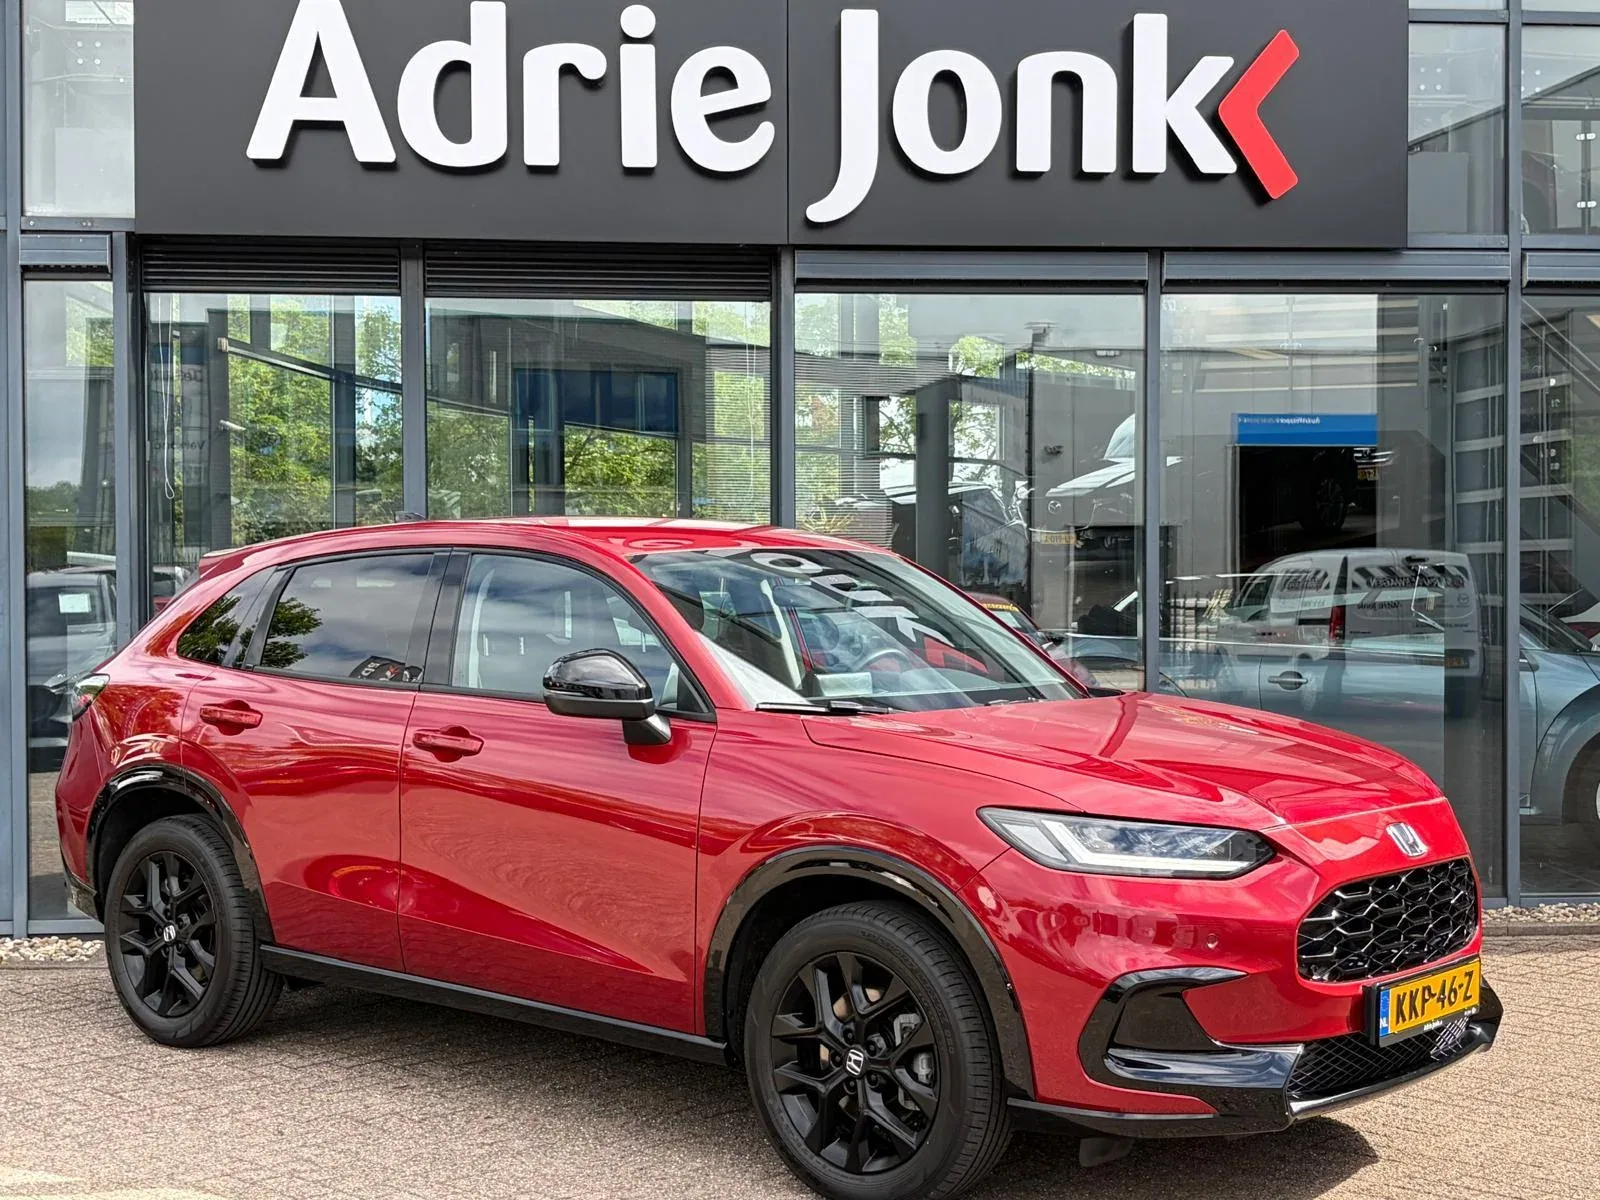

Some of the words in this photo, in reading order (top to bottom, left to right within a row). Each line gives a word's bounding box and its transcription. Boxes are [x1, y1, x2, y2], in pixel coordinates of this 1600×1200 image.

[246, 0, 774, 171] Adrie
[806, 9, 1236, 222] Jonk
[1379, 1016, 1389, 1028] NL
[1396, 970, 1474, 1026] KKP-46-Z
